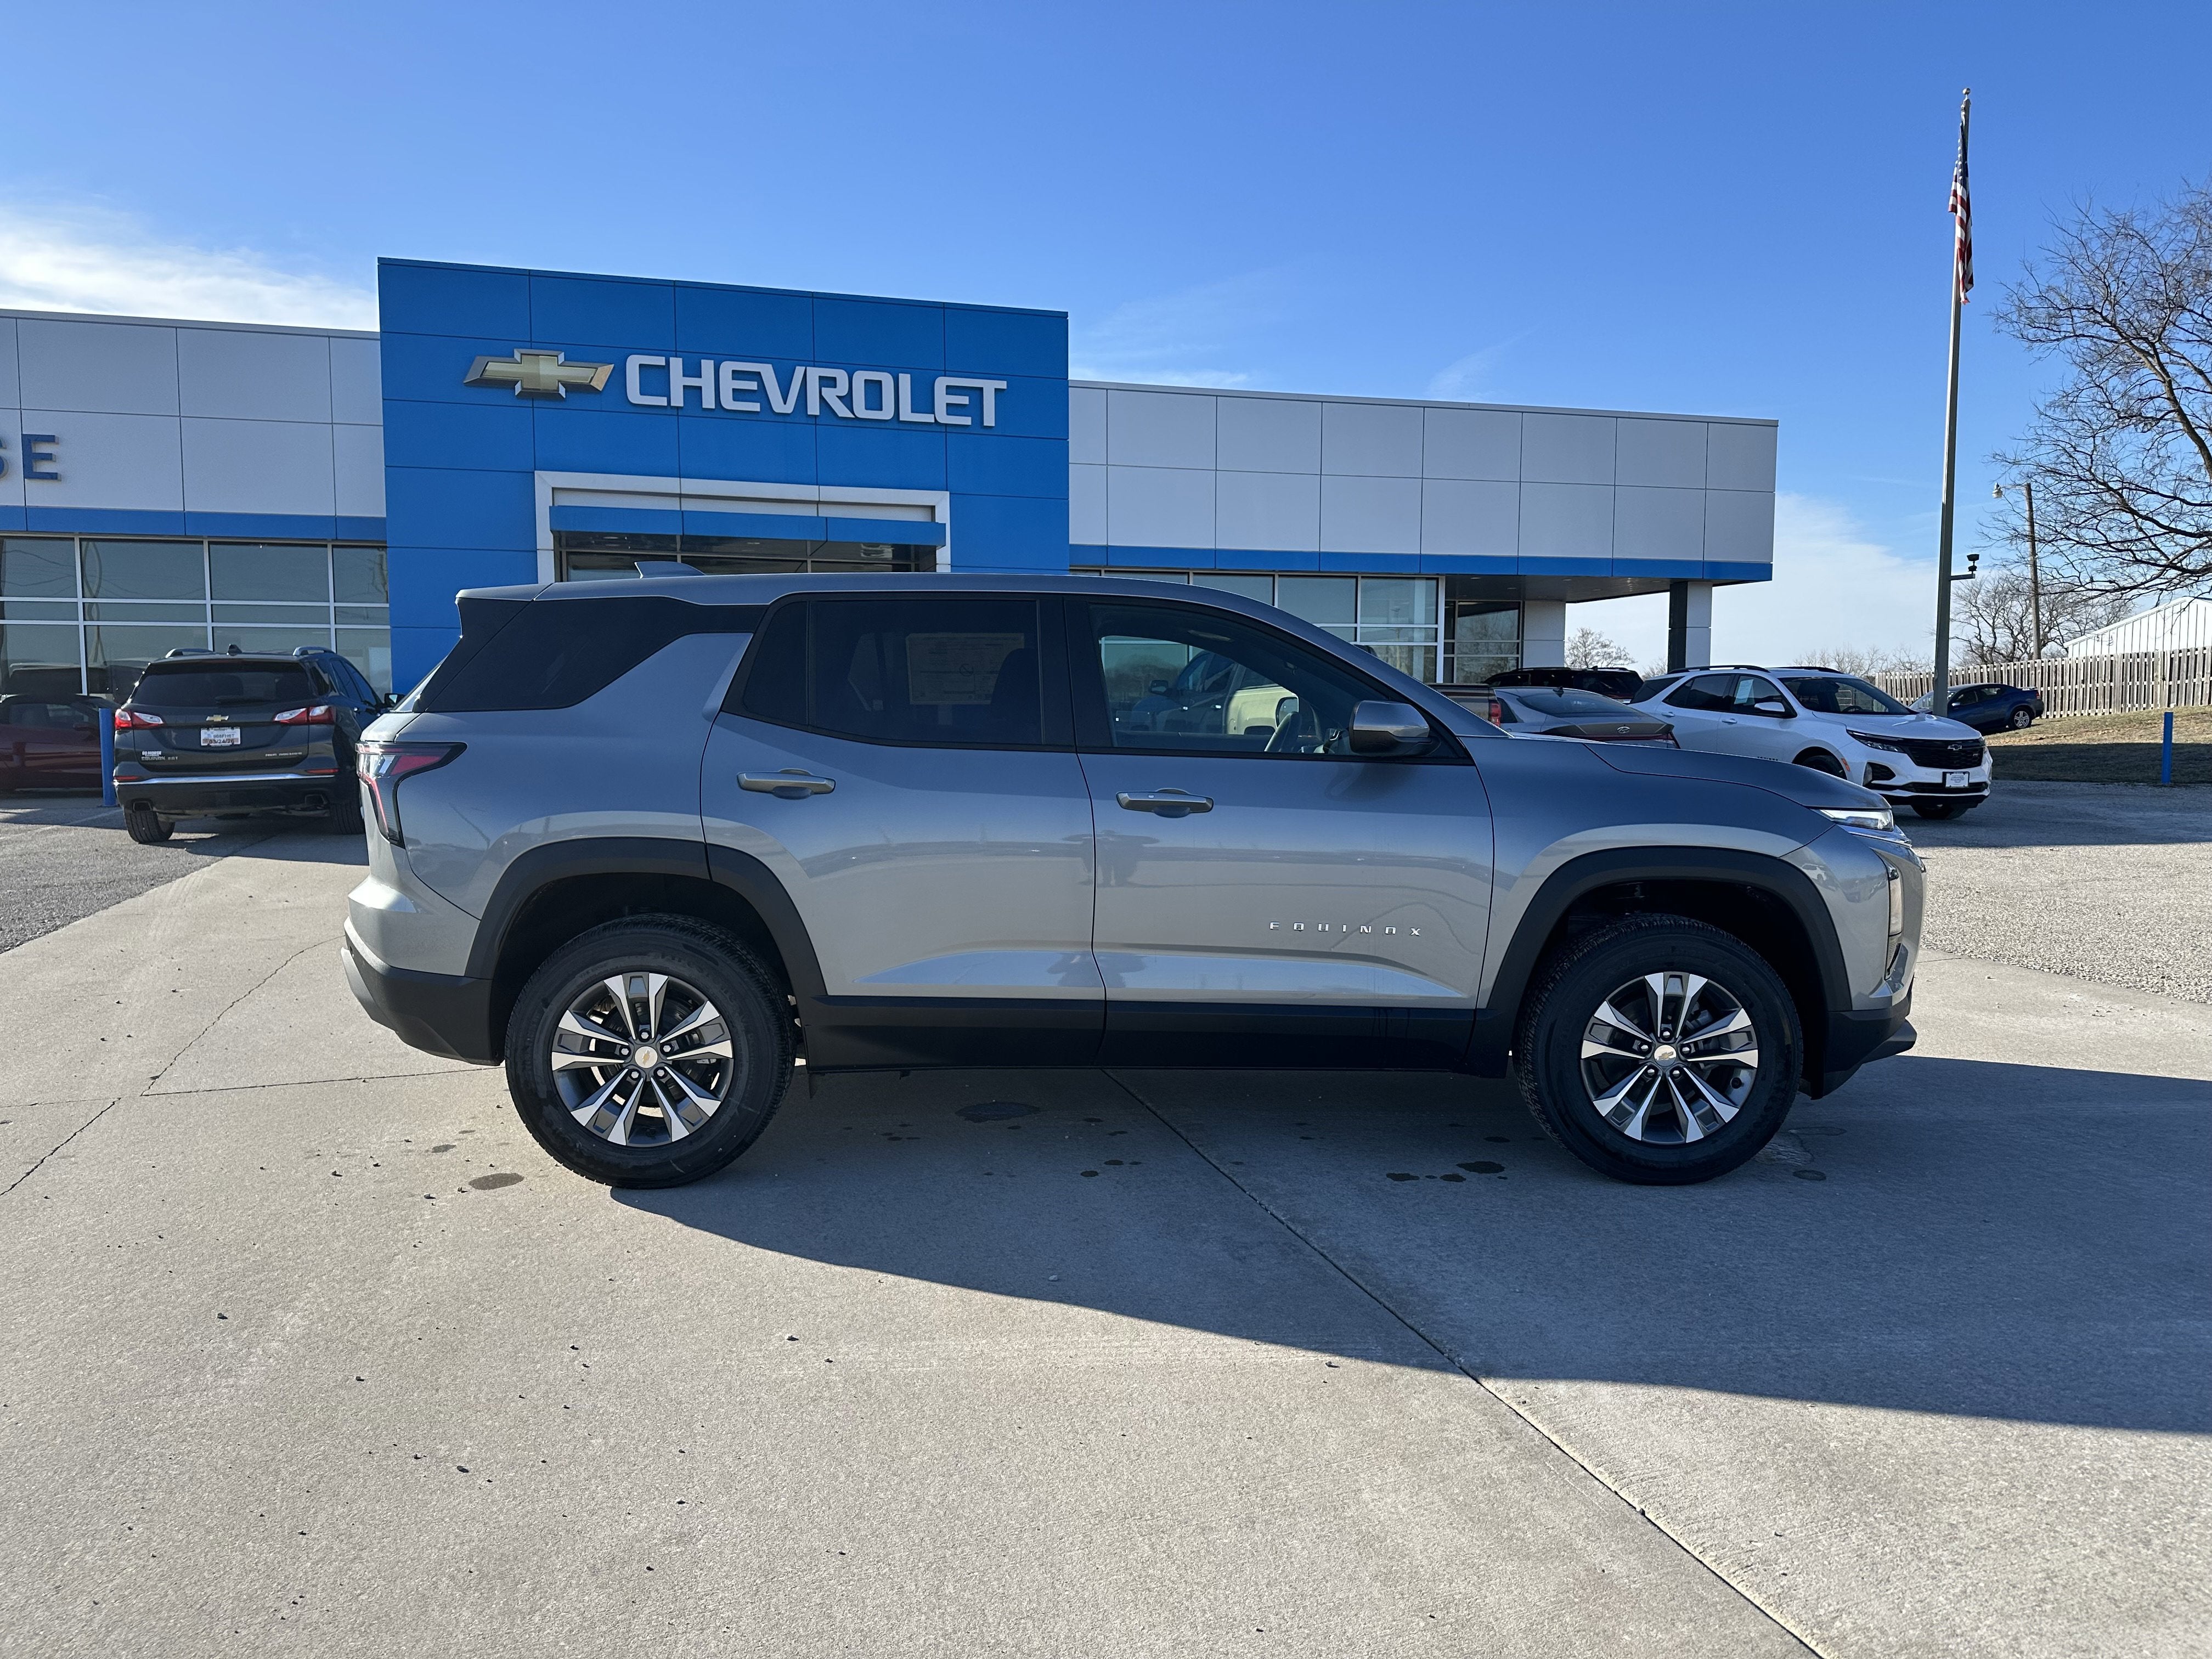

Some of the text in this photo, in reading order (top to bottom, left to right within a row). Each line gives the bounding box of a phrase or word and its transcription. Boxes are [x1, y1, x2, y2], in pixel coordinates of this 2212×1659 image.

[626, 354, 1007, 426] CHEVROLET
[0, 434, 60, 481] E
[1269, 921, 1421, 936] EQUINOX
